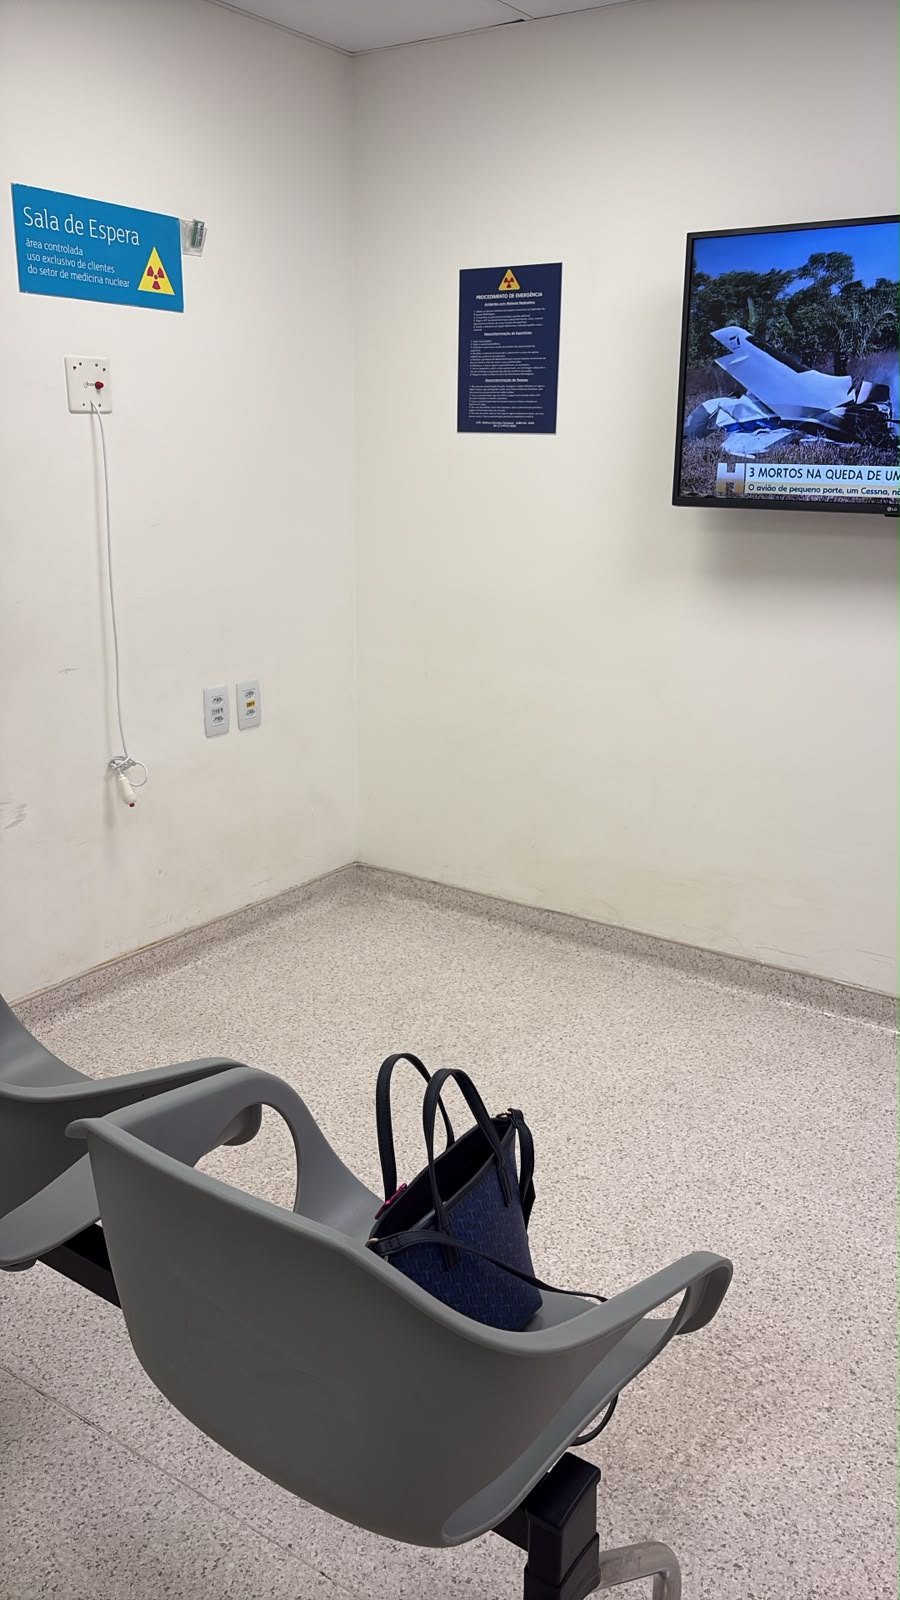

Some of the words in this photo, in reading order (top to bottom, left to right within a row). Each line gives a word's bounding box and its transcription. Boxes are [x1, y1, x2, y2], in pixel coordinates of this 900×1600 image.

[23, 206, 60, 232] Sala
[64, 213, 84, 236] de
[89, 219, 140, 246] Espera
[25, 237, 43, 250] área
[44, 241, 83, 256] controlada
[27, 252, 41, 262] uso
[42, 254, 76, 268] exclusivo
[77, 258, 87, 270] de
[87, 260, 115, 274] clientes
[27, 264, 38, 275] do
[39, 266, 59, 278] setor
[59, 269, 69, 280] de
[70, 271, 104, 285] medicina
[104, 275, 130, 288] nuclear
[515, 291, 543, 299] EMERGÊNCIA
[748, 467, 755, 479] 3
[758, 467, 803, 479] MORTOS
[807, 468, 822, 479] NA
[825, 468, 864, 481] QUEDA
[867, 469, 881, 481] DE
[756, 483, 776, 492] avião
[778, 484, 788, 493] de
[789, 485, 821, 495] pequeno
[822, 486, 845, 495] porte,
[861, 487, 890, 497] Cessna,
